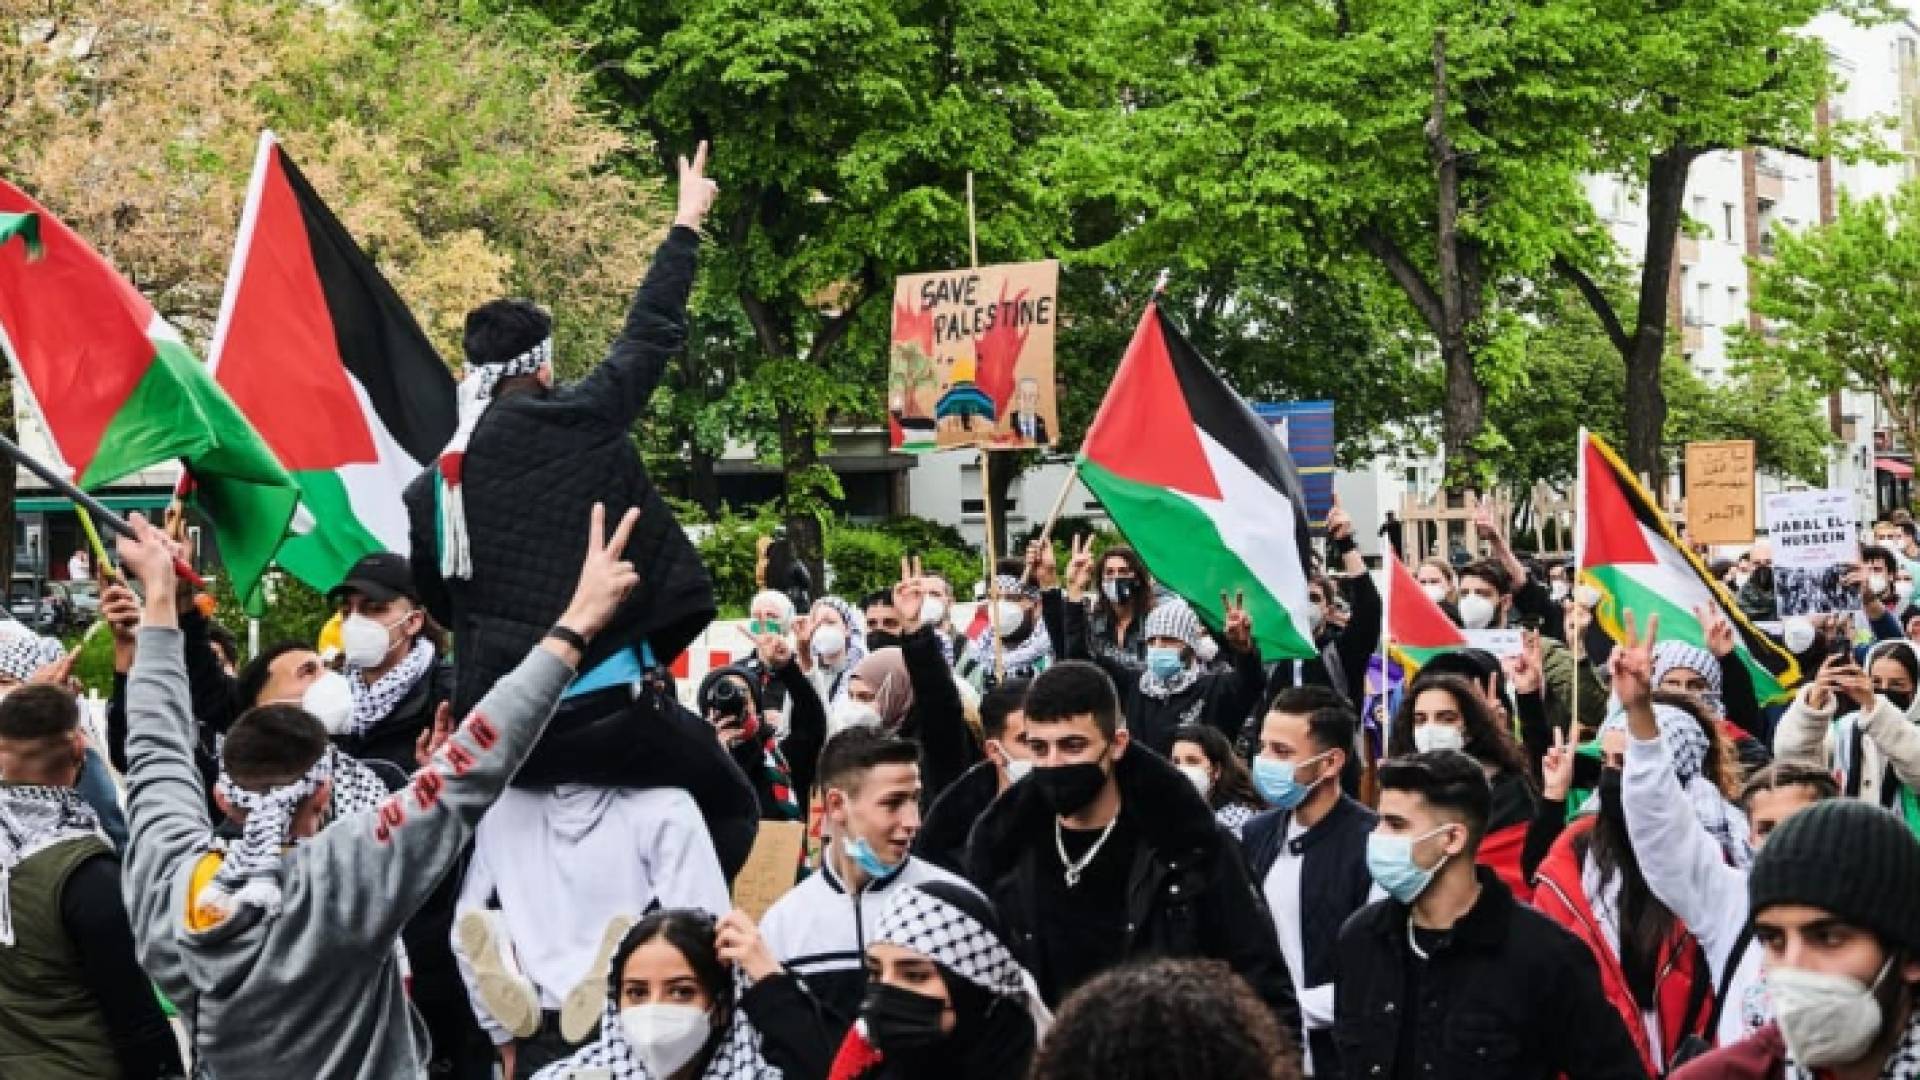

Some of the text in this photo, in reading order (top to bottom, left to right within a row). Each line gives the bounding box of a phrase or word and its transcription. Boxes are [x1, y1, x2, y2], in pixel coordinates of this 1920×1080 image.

[921, 275, 979, 311] SAVE
[934, 297, 1052, 344] PALESTINE
[1771, 518, 1822, 532] JABAL
[1781, 532, 1845, 546] HUSSEIN
